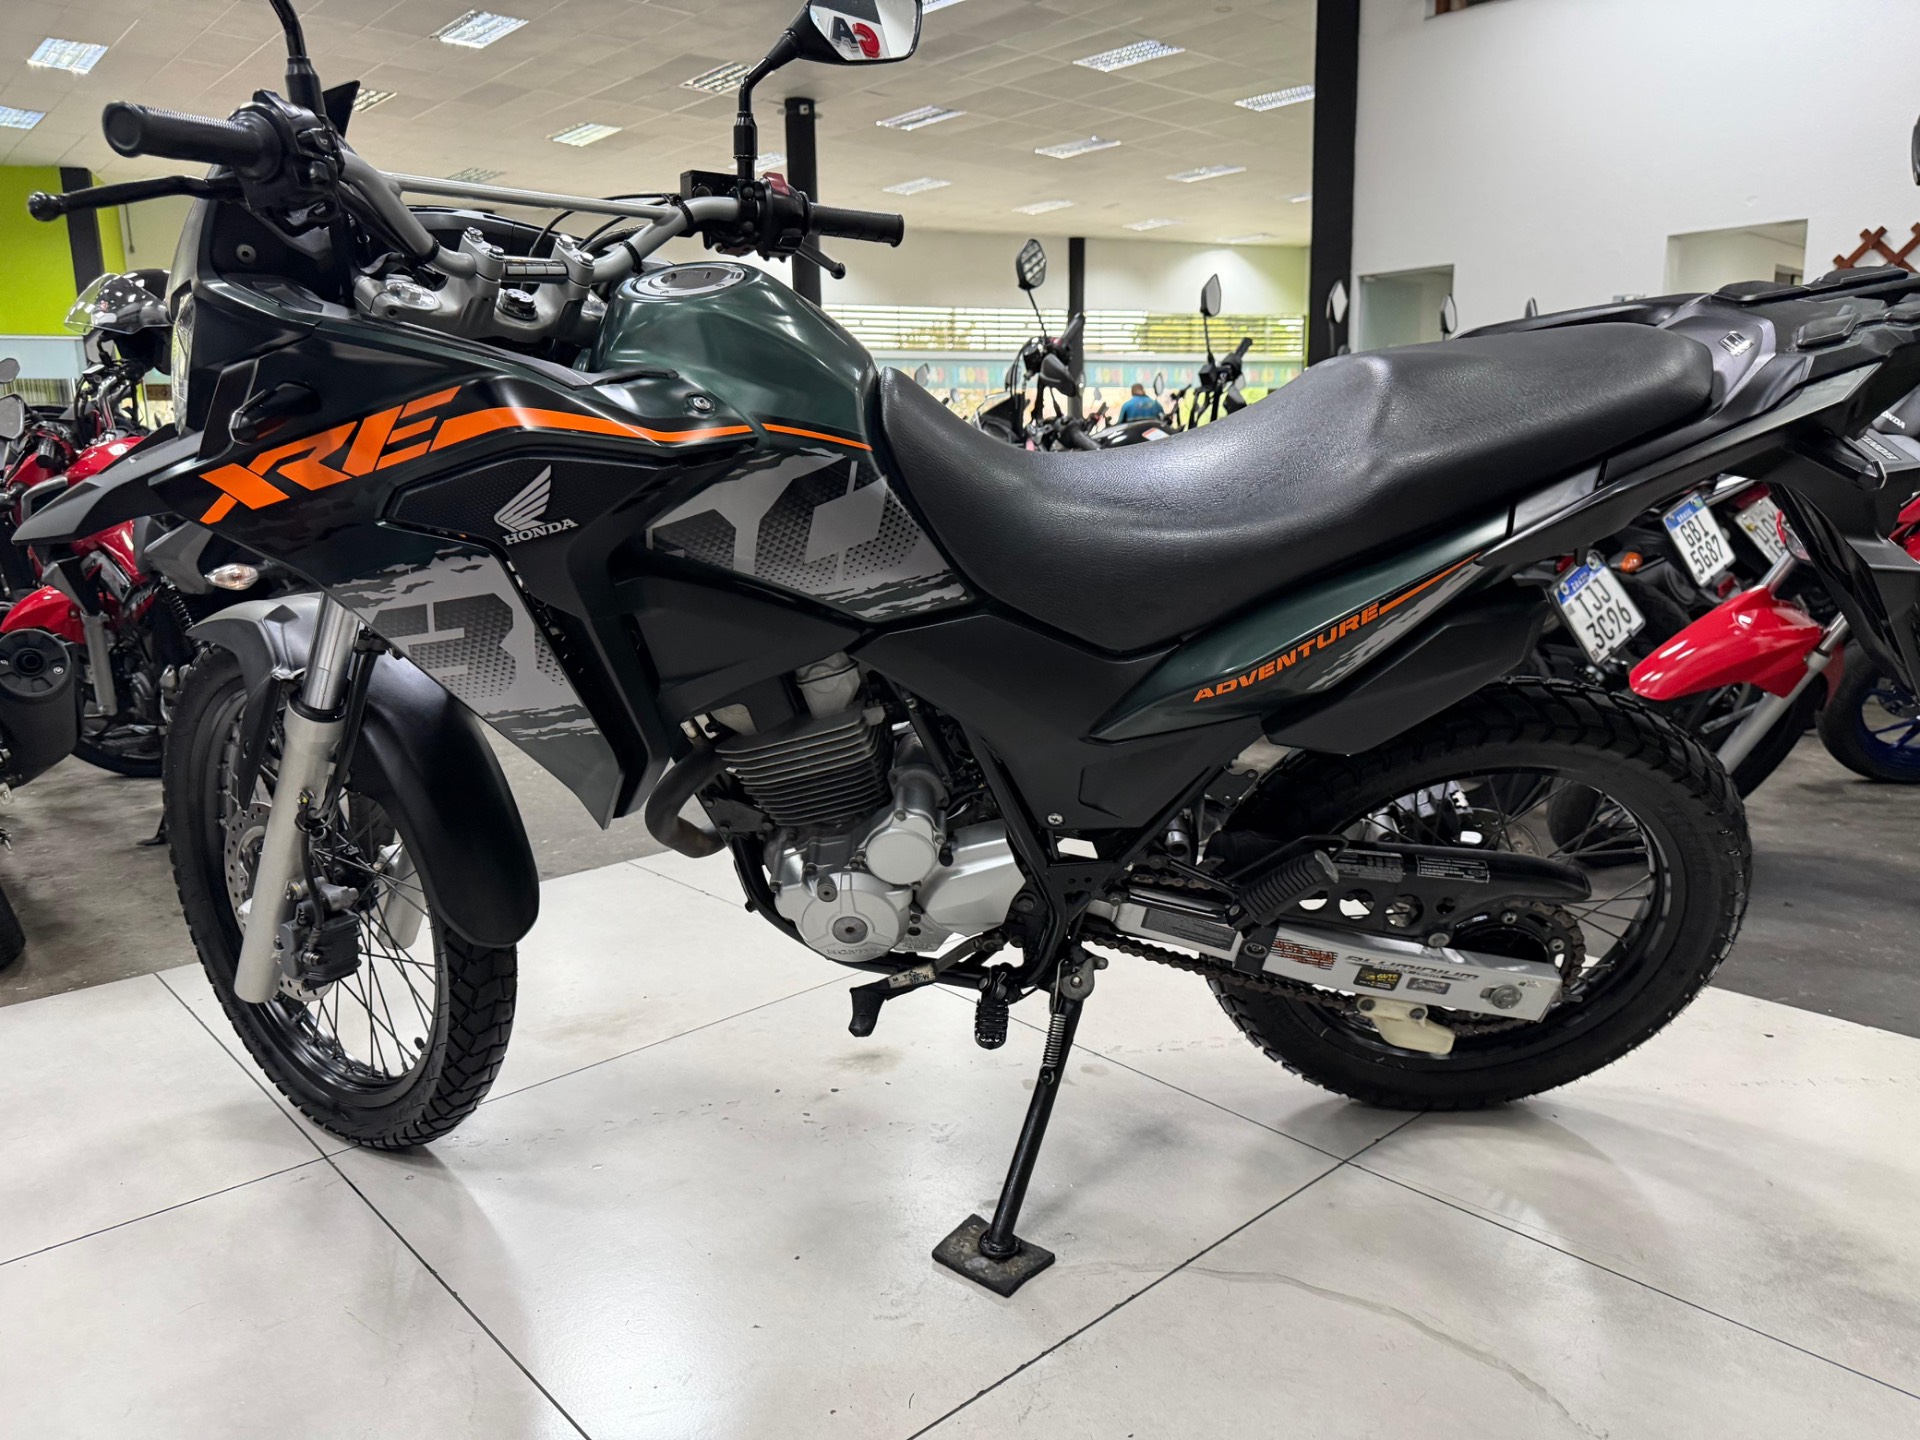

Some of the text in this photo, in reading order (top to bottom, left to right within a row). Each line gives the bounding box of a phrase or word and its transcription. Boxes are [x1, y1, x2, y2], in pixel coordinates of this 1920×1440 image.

[1880, 410, 1906, 430] ONDA
[199, 385, 462, 525] XRE
[503, 518, 579, 546] HONDA
[1680, 514, 1710, 548] GBI
[1689, 533, 1724, 574] 5G87
[1574, 576, 1612, 619] TJJ
[1585, 598, 1633, 650] 3C96
[1193, 602, 1380, 703] ADVENTURE
